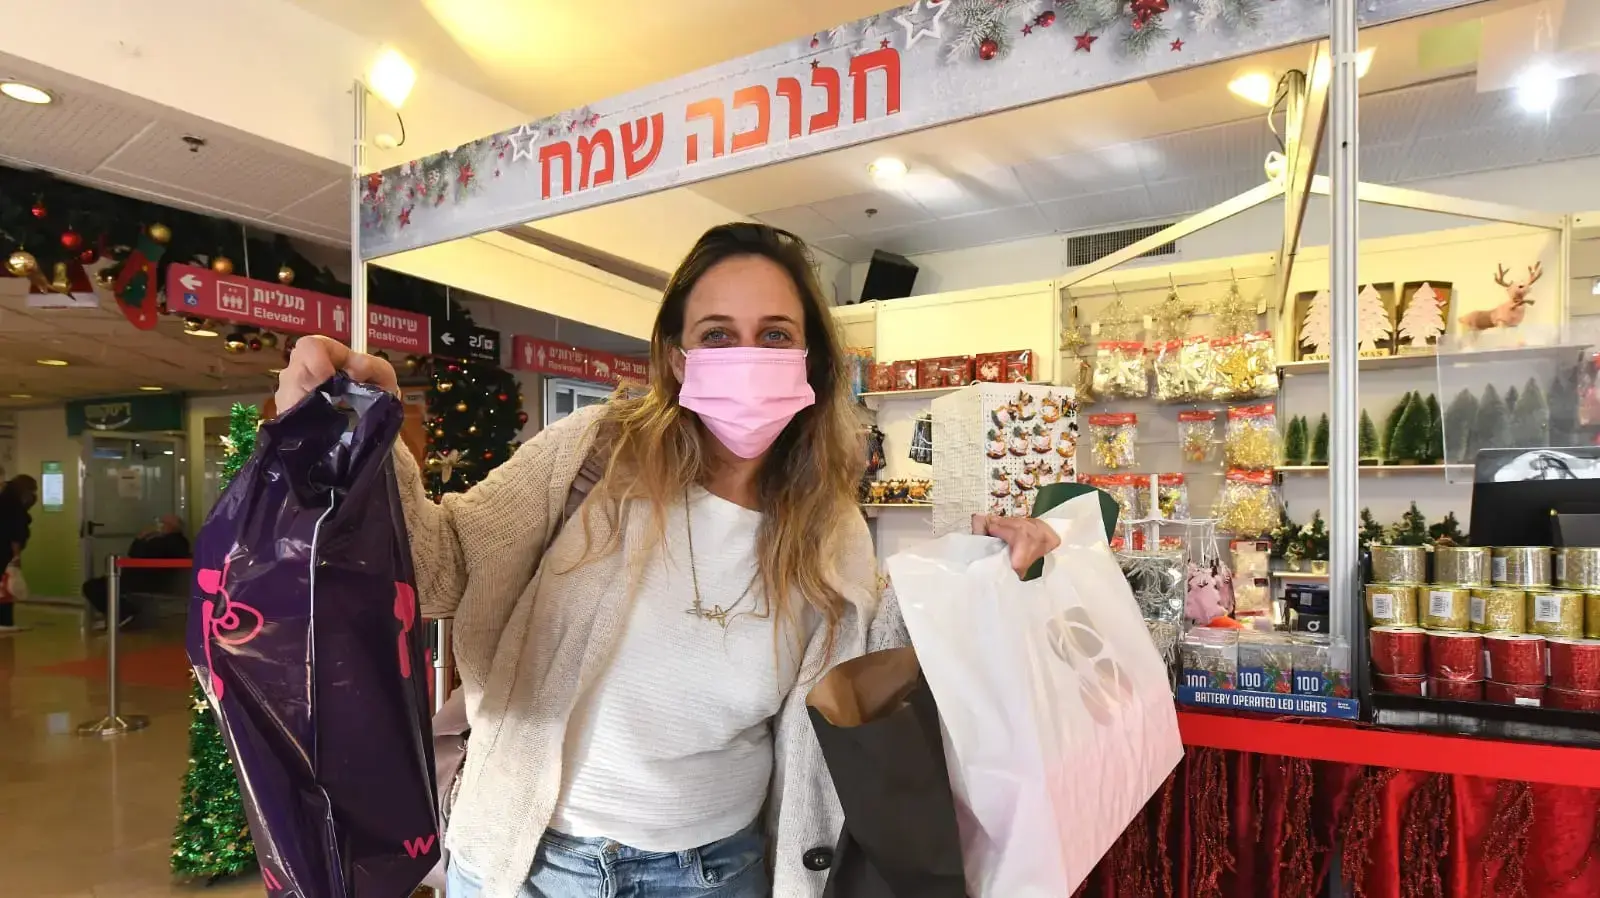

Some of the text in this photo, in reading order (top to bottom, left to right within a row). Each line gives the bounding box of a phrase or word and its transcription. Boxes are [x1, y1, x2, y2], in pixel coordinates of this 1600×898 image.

[538, 47, 901, 200] חנוכה שמח
[253, 287, 305, 310] מעליות
[253, 307, 306, 326] Elevator
[369, 312, 418, 332] שירותים
[368, 328, 418, 346] Restroom
[1240, 672, 1261, 688] 100
[1297, 676, 1319, 692] 100
[1195, 691, 1231, 705] BATTERY
[1232, 695, 1277, 709] OPERATED
[1278, 698, 1294, 711] LED
[1296, 699, 1327, 714] LIGHTS
